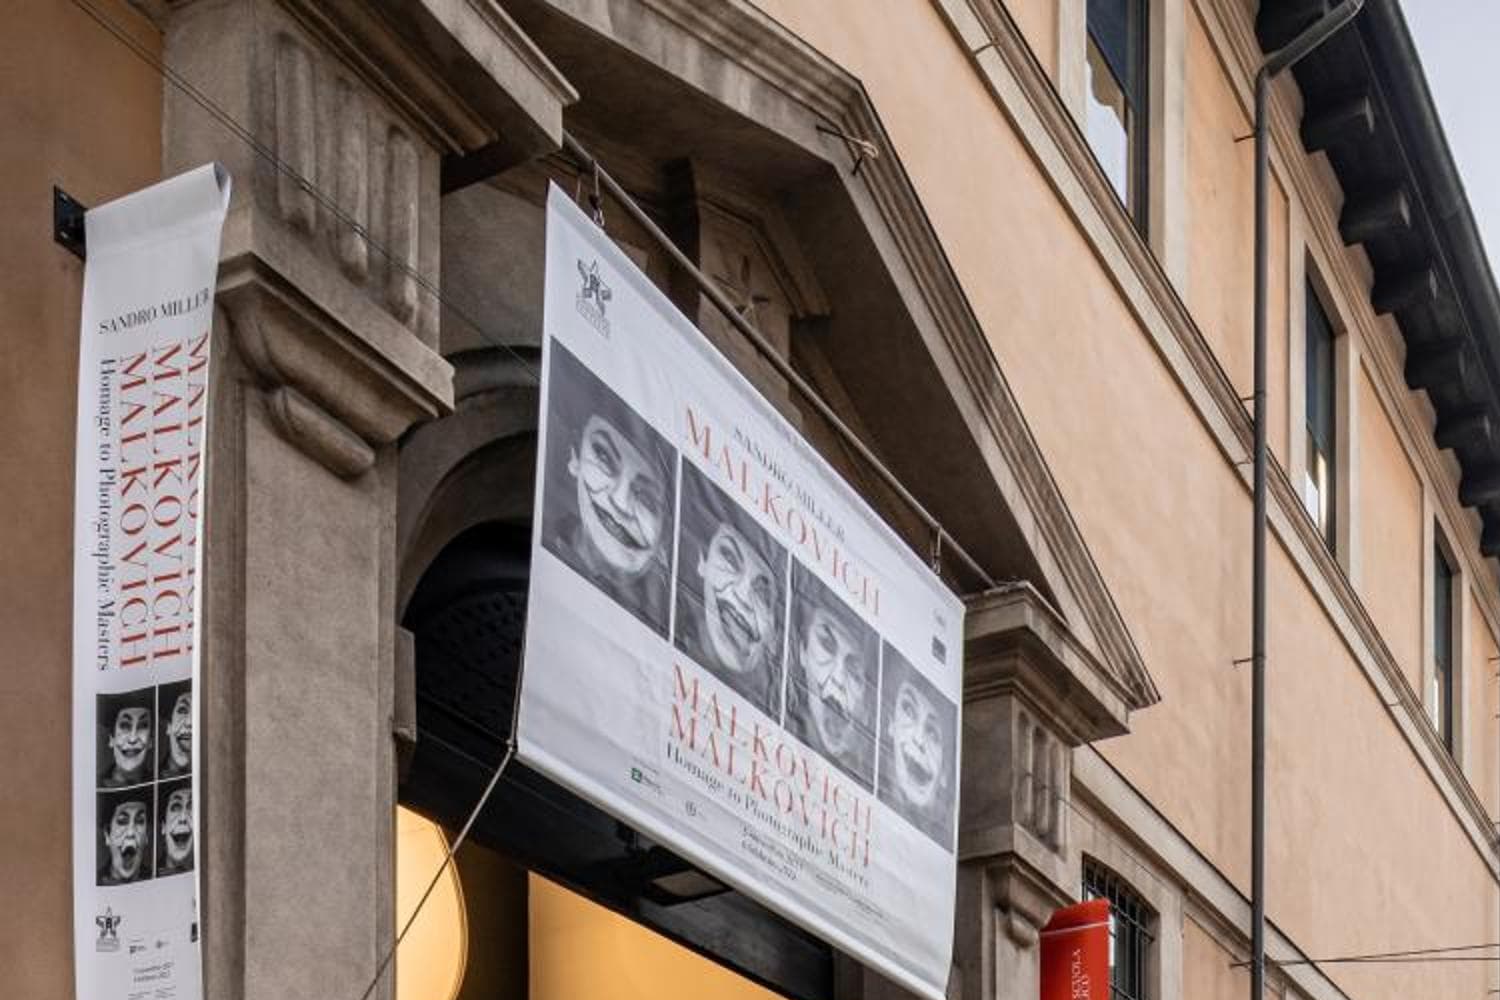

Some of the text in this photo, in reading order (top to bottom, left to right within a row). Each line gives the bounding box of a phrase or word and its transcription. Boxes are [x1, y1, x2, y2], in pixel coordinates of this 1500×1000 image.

[98, 304, 157, 334] SANDRO
[91, 359, 117, 672] Homage to Photographic Masters
[119, 352, 149, 666] MALKOVICH
[152, 343, 183, 659] MALKOVICH
[686, 407, 881, 617] MALKOVICH
[666, 741, 725, 793] Homage
[669, 702, 871, 868] MALKOVICH
[672, 662, 872, 840] MALKOVICH
